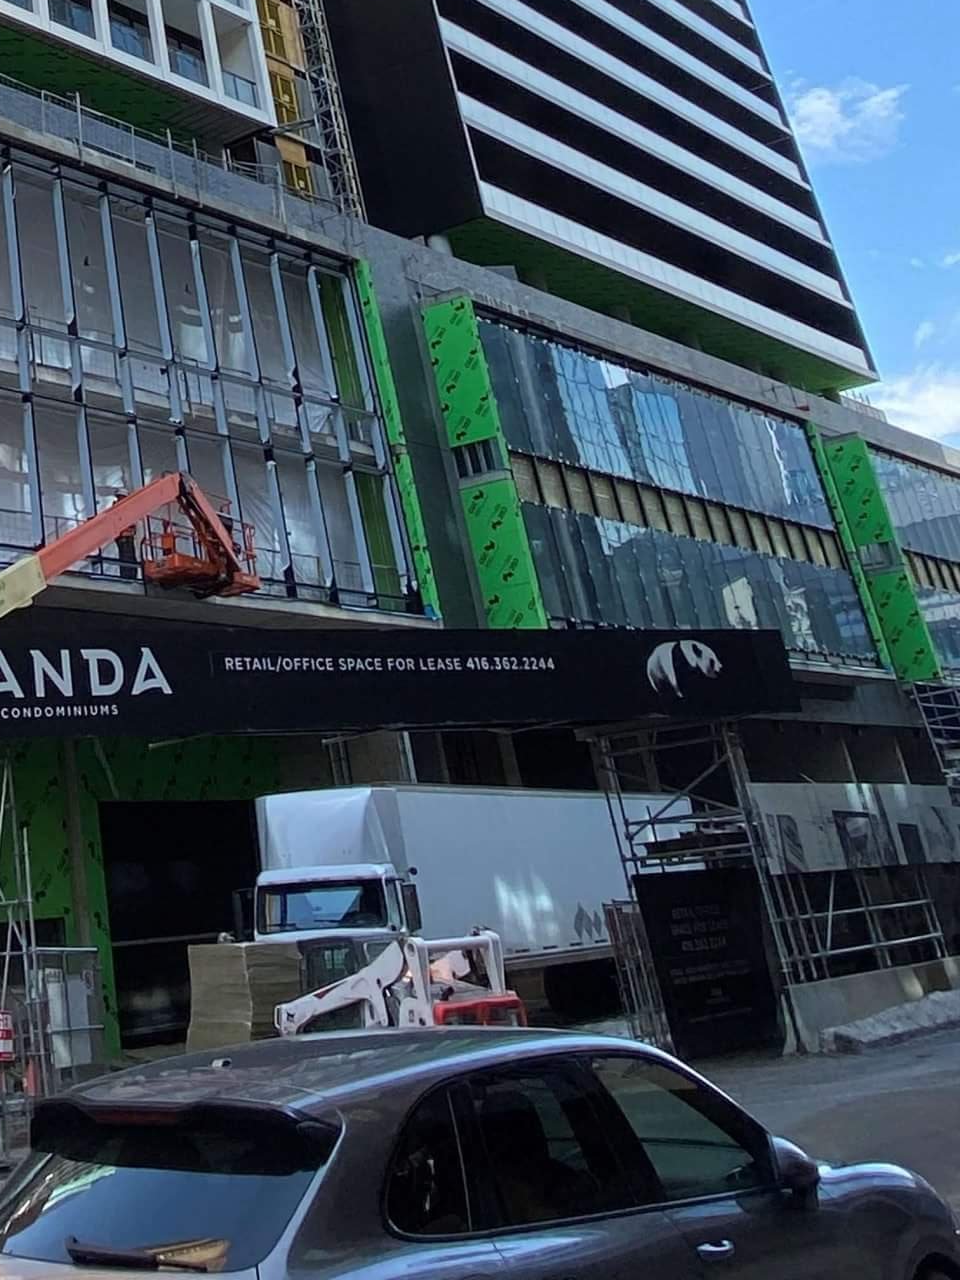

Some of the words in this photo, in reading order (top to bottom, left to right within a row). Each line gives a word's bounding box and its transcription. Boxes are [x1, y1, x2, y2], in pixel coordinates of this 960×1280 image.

[224, 656, 335, 672] RETAIL/OFFICE
[338, 658, 383, 671] SPACE
[387, 658, 415, 671] FOR
[419, 658, 463, 671] LEASE
[466, 656, 556, 670] 416.362.2244
[0, 704, 120, 719] CONDOMINIUMS
